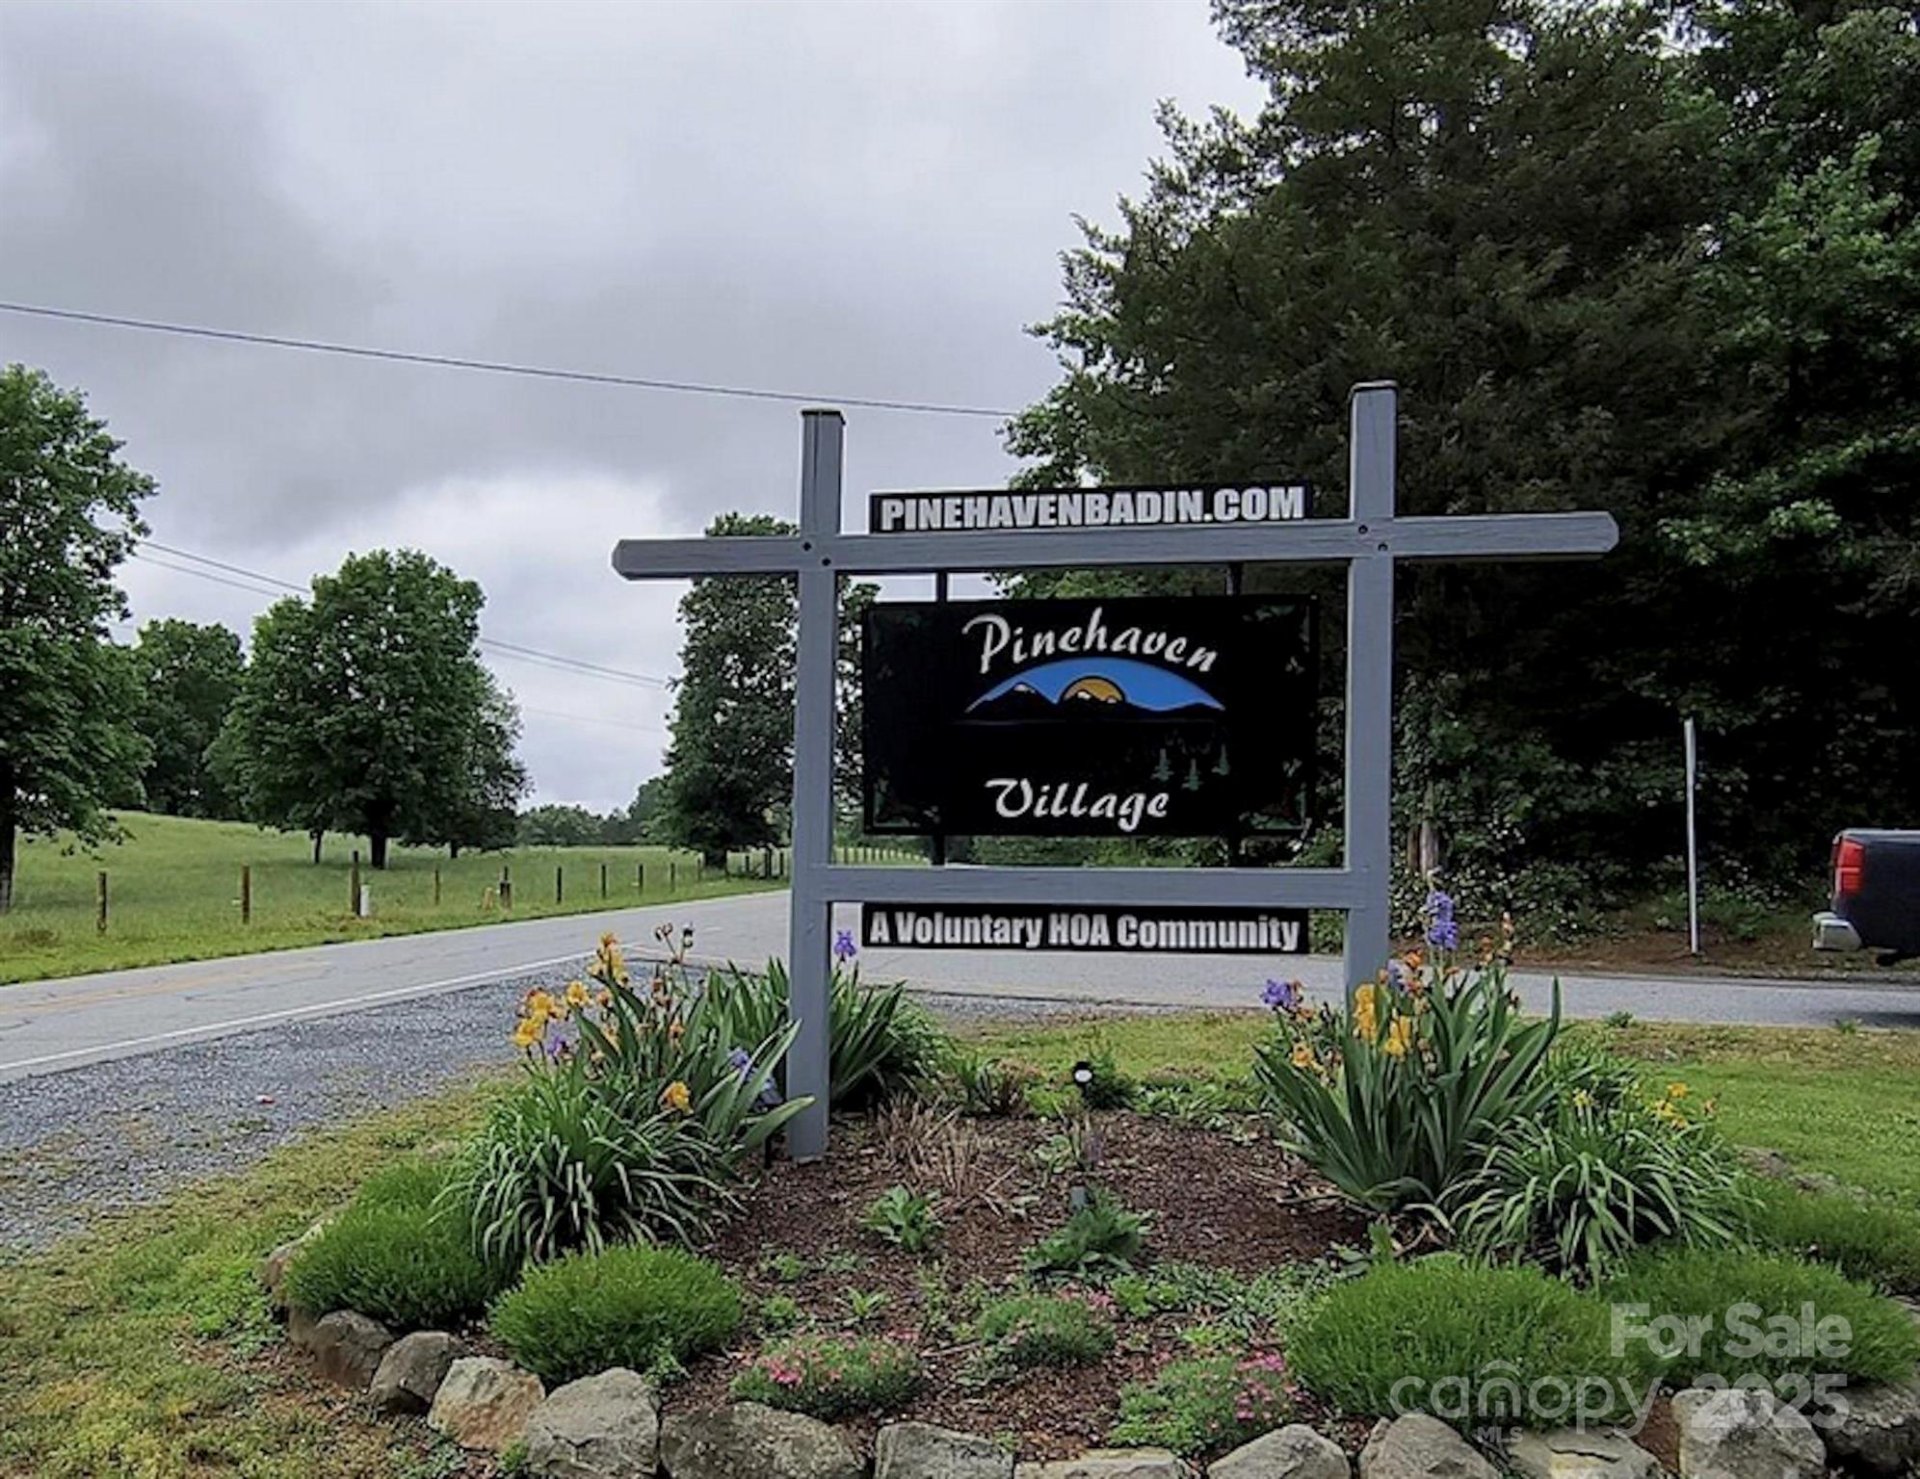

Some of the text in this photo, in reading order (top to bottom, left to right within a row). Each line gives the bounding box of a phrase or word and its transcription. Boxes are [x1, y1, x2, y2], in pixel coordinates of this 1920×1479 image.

[881, 486, 1305, 531] PINEHAVENBADIN.COM
[961, 606, 1219, 674] Pinehaven
[985, 778, 1170, 832] Village
[869, 911, 1300, 951] A Voluntary HOA Community
